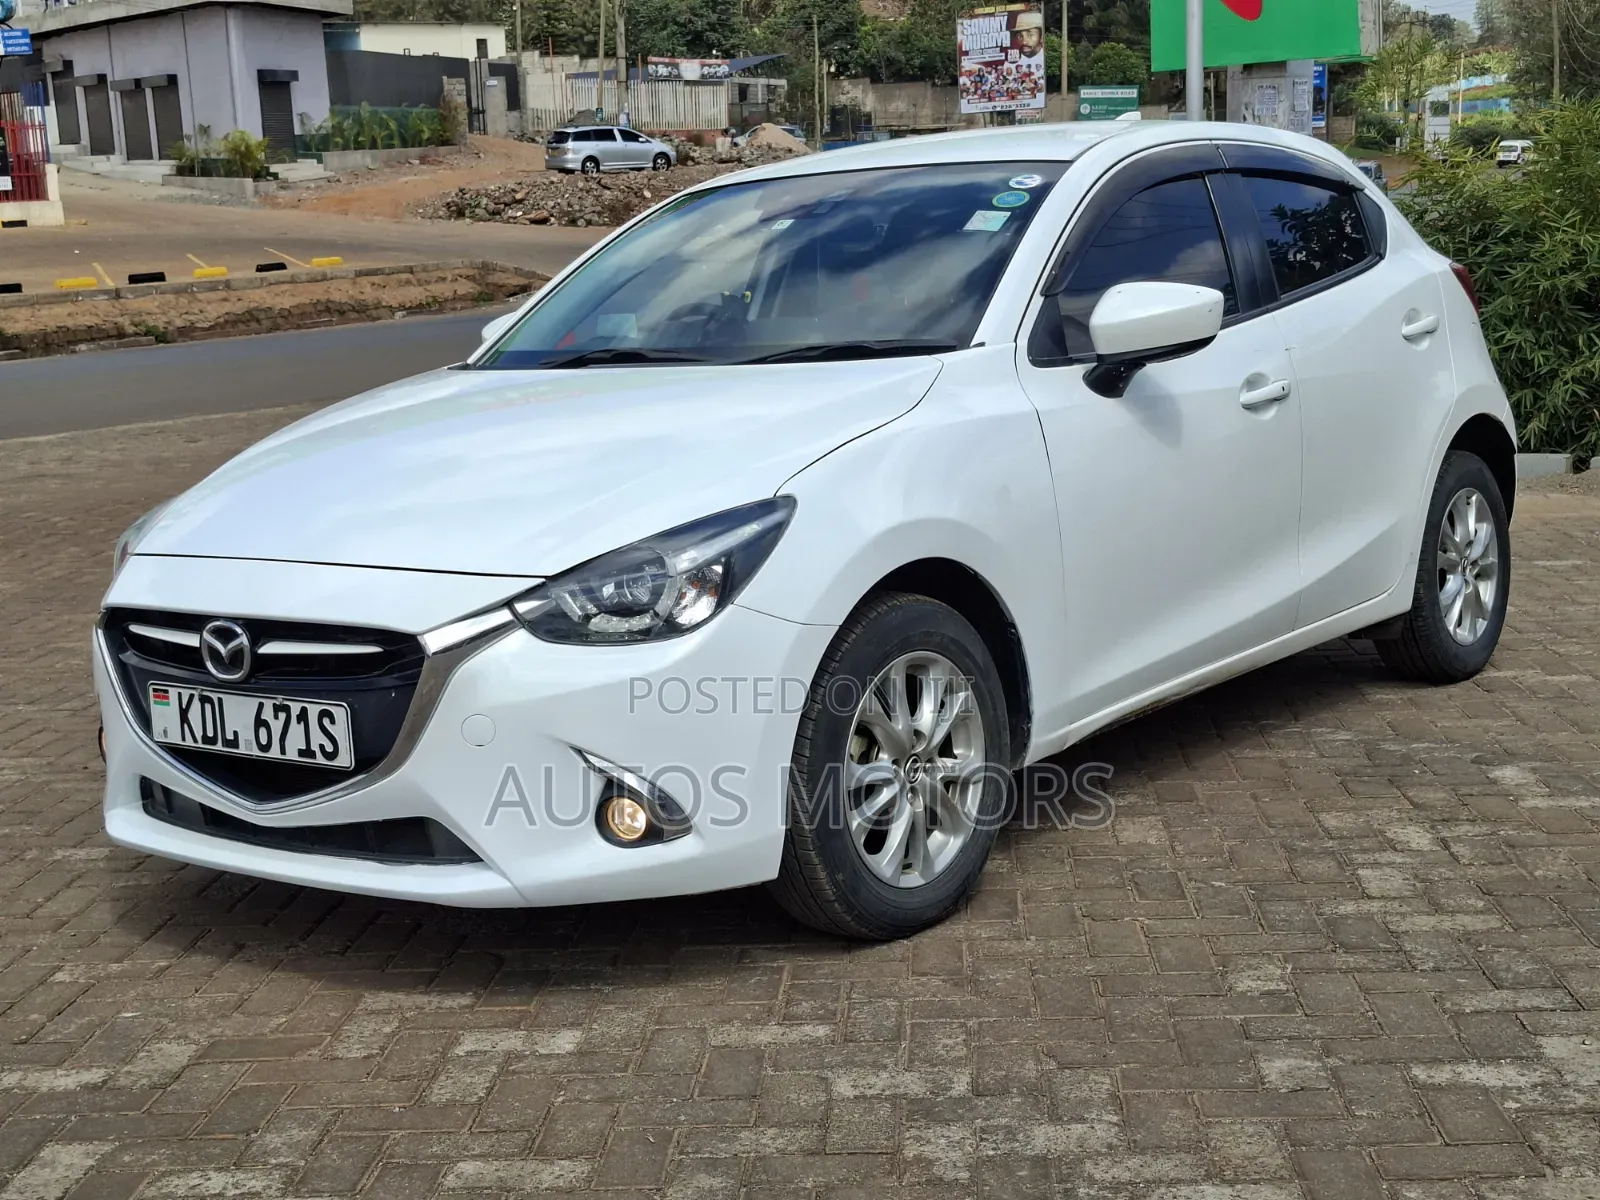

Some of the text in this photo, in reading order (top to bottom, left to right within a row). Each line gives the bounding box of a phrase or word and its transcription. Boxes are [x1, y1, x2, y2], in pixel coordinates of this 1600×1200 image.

[963, 15, 1008, 35] SAMMY
[177, 691, 240, 749] KDL
[253, 701, 340, 762] 671S
